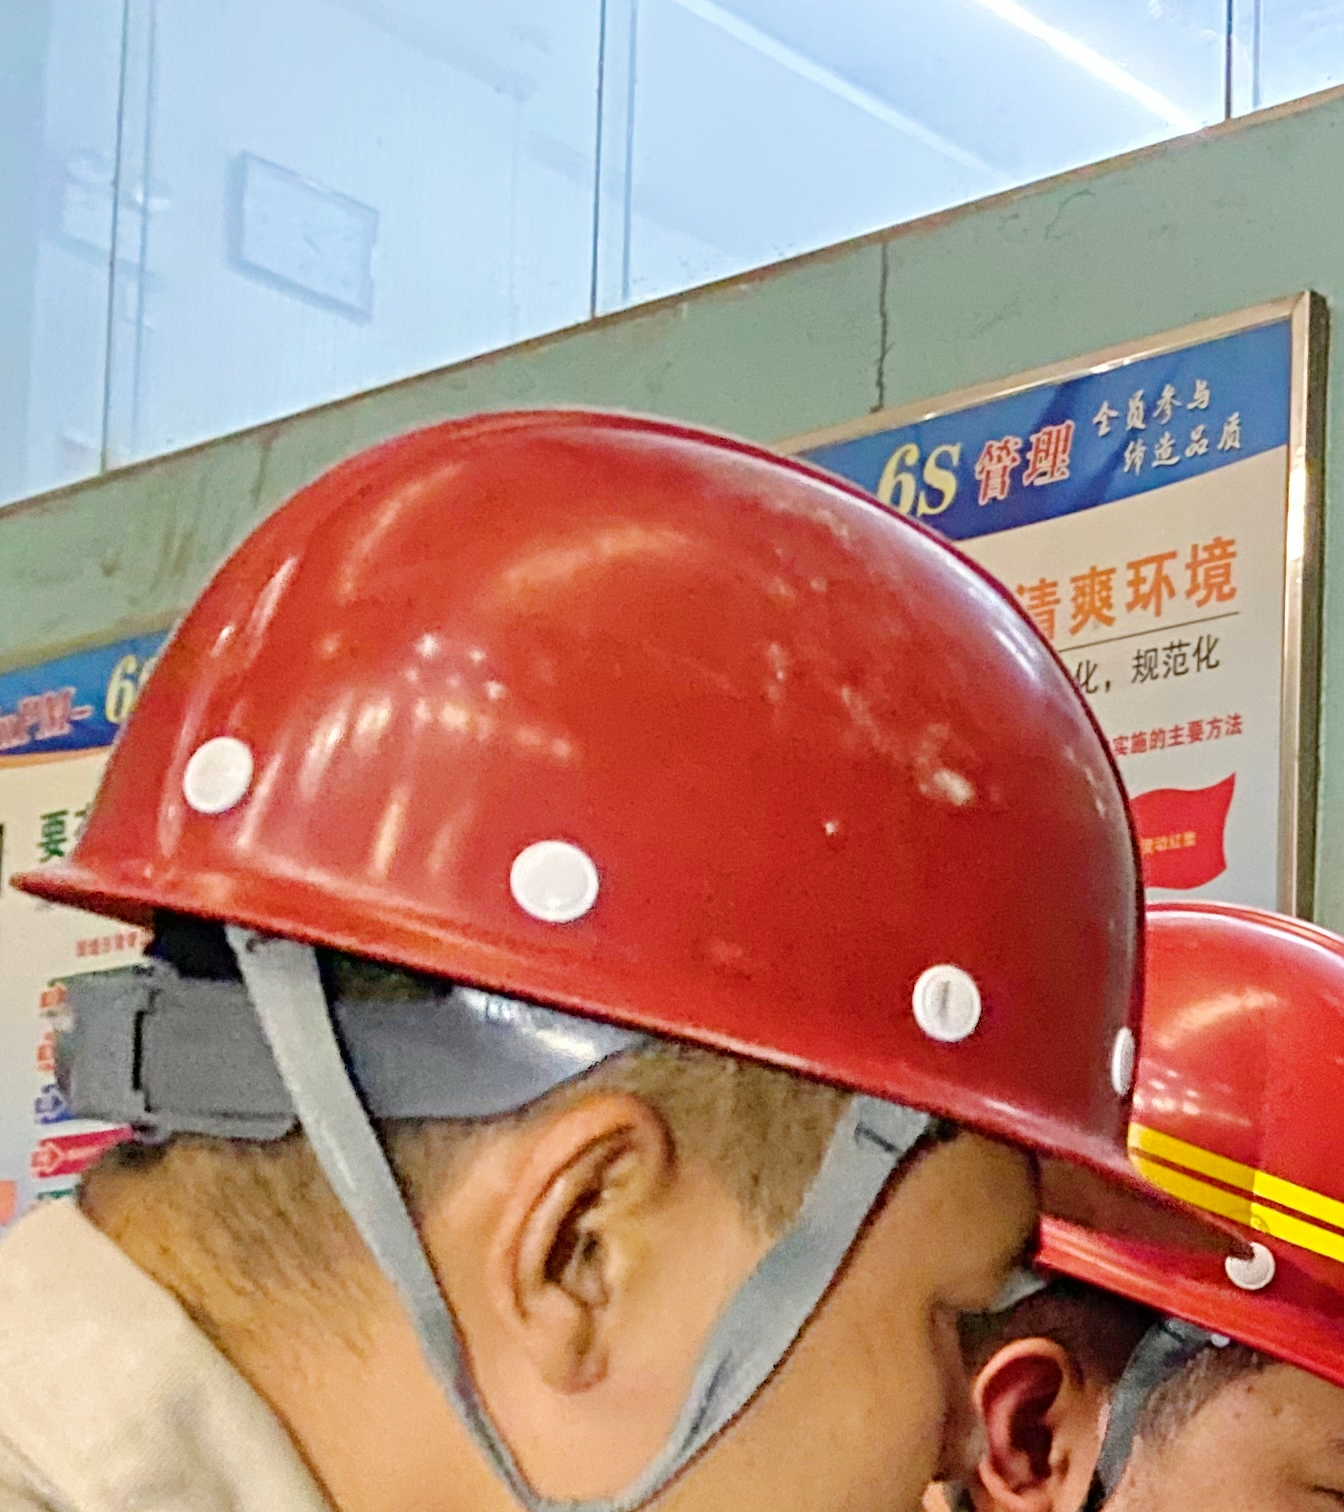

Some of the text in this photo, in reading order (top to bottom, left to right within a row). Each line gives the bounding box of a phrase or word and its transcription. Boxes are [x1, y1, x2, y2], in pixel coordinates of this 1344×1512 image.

[1092, 379, 1211, 437] 全员参与
[876, 419, 1076, 517] 6S 管理
[1112, 712, 1244, 757] 实施的主要方法
